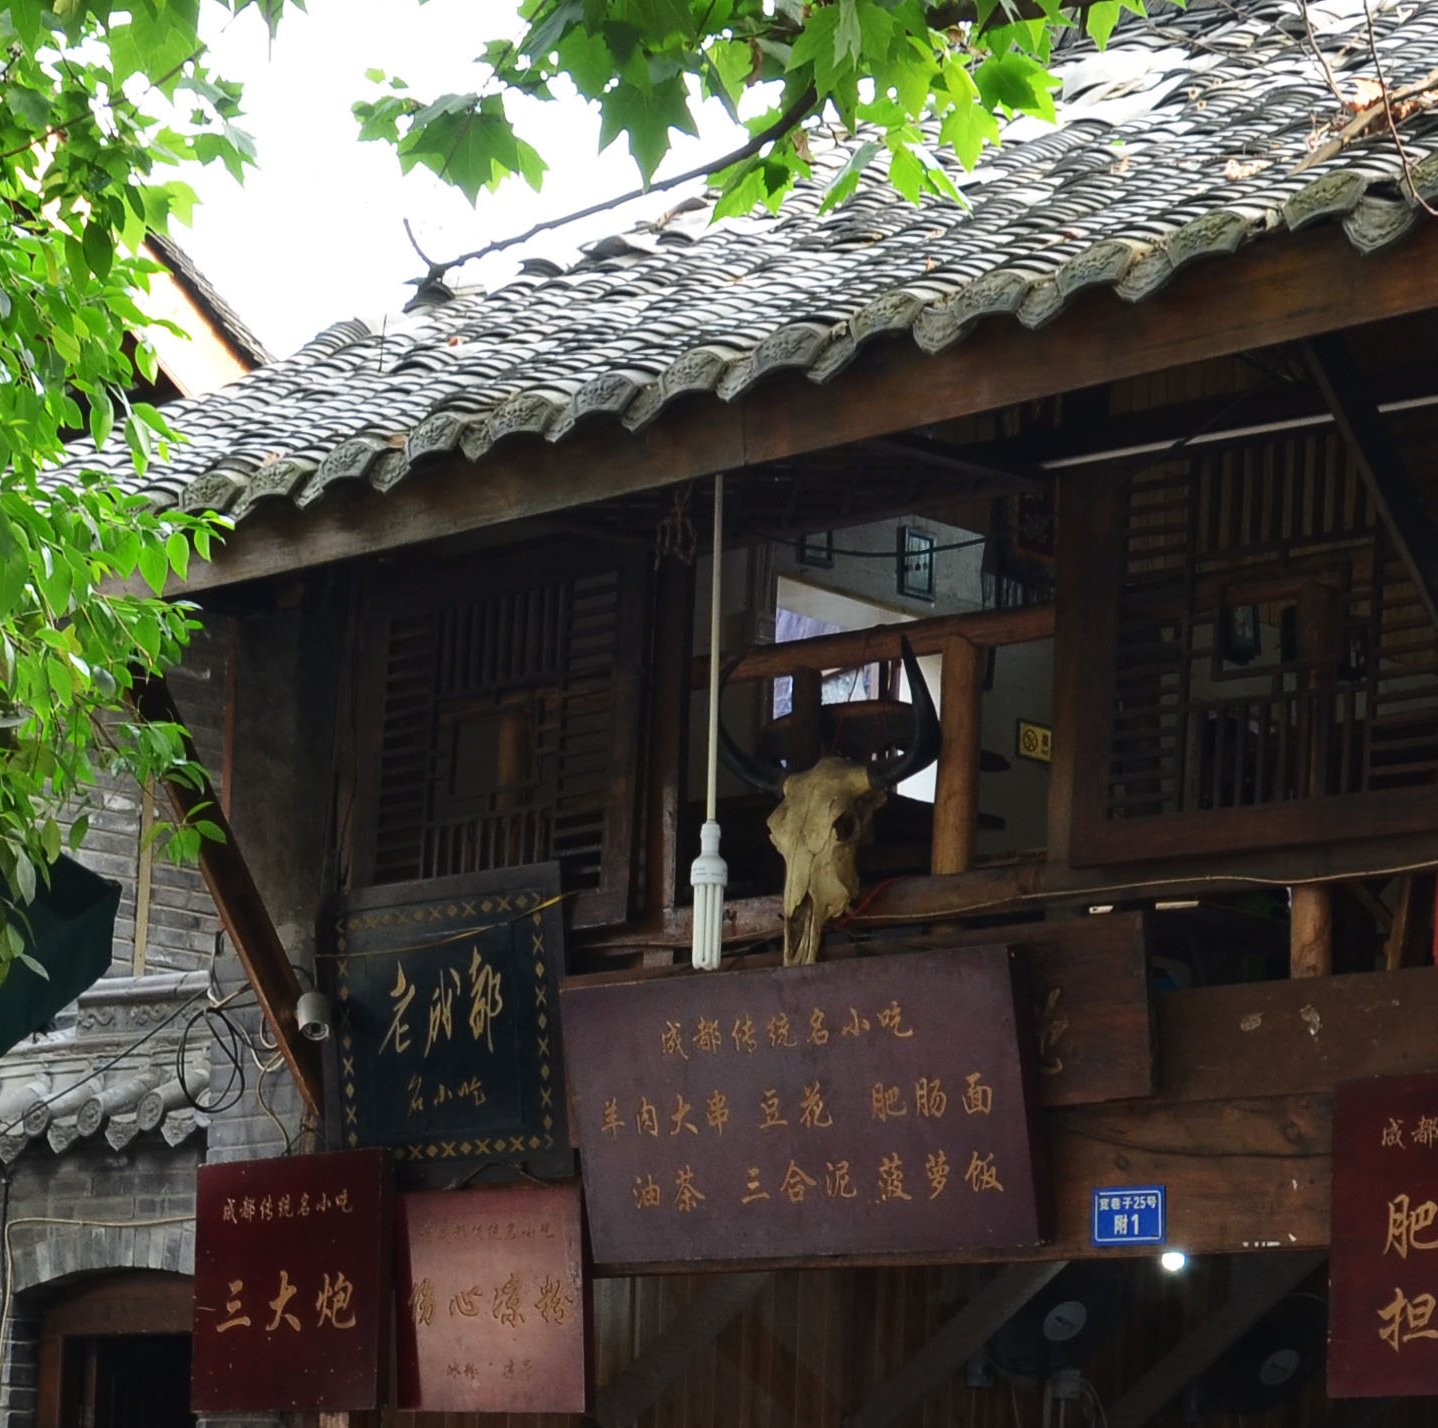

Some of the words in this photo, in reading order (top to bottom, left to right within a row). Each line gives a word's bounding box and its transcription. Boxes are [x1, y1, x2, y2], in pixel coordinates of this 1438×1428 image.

[661, 1001, 914, 1060] 成都传统名小吃
[601, 1089, 729, 1140] 羊肉大串
[759, 1081, 833, 1129] 豆花
[871, 1072, 993, 1122] 肥肠面
[632, 1164, 706, 1212] 油茶
[739, 1159, 858, 1205] 三合泥
[216, 1269, 357, 1333] 三大炮
